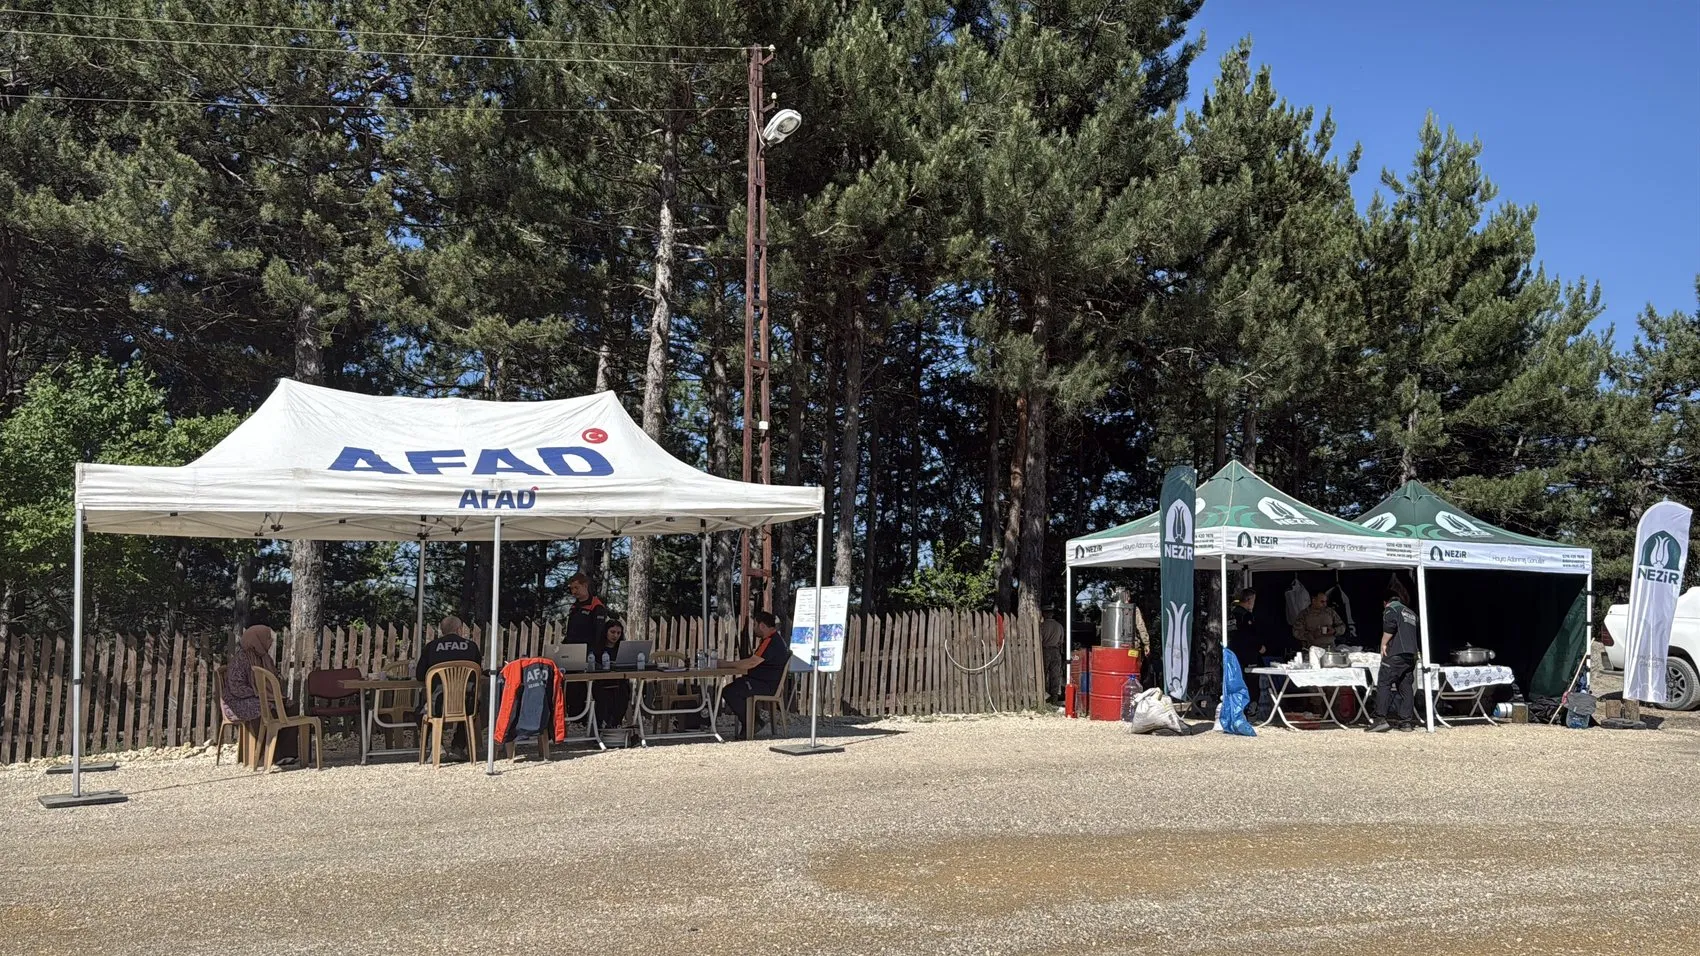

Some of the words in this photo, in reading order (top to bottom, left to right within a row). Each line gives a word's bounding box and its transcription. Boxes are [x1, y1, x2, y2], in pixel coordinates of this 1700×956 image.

[327, 446, 615, 476] AFAD
[458, 489, 536, 509] AFAD
[436, 641, 469, 652] AFAD
